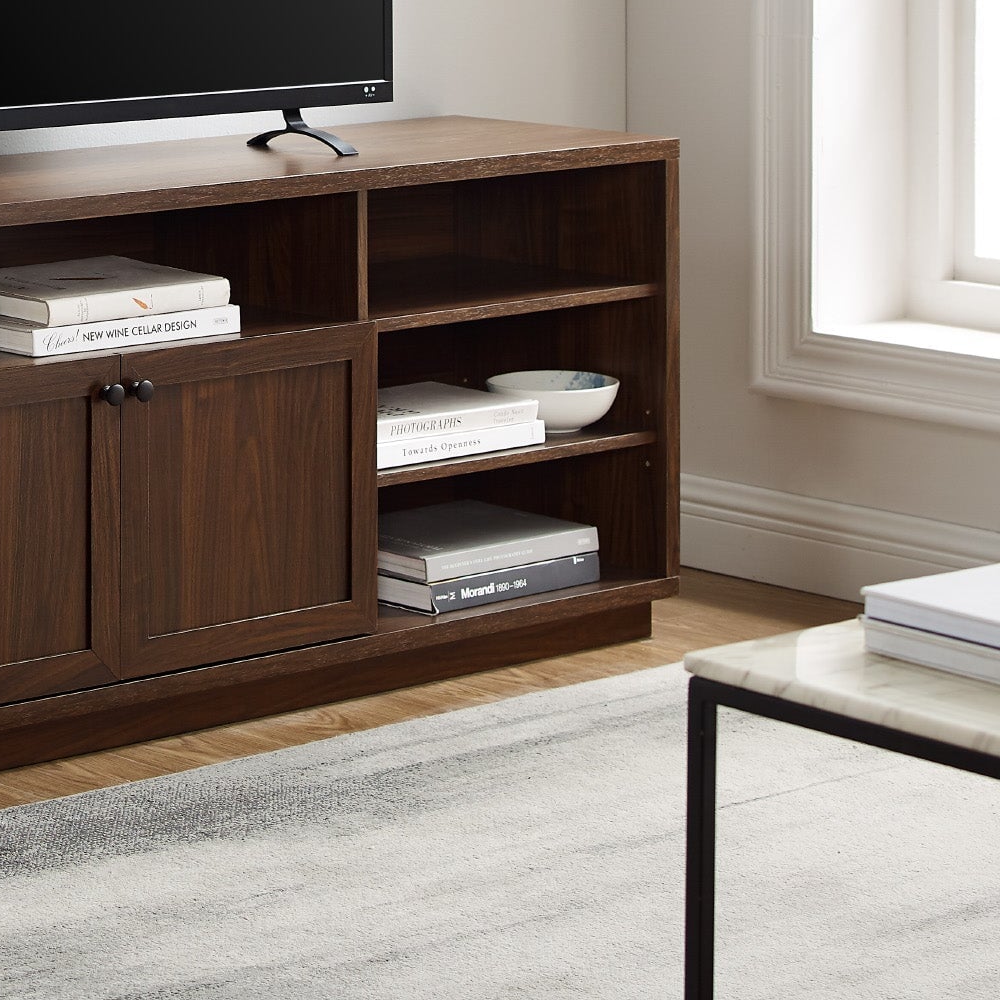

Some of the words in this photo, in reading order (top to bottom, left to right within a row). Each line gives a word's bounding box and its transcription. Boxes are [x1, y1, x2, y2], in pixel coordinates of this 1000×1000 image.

[82, 329, 104, 343] NEW
[105, 326, 130, 340] WINE
[131, 323, 162, 337] CELLAR
[164, 319, 197, 333] DESIGN
[390, 416, 463, 436] PHOTOGRAPHS
[402, 444, 438, 457] Towards
[440, 438, 481, 453] Openness
[460, 582, 495, 599] Morandi
